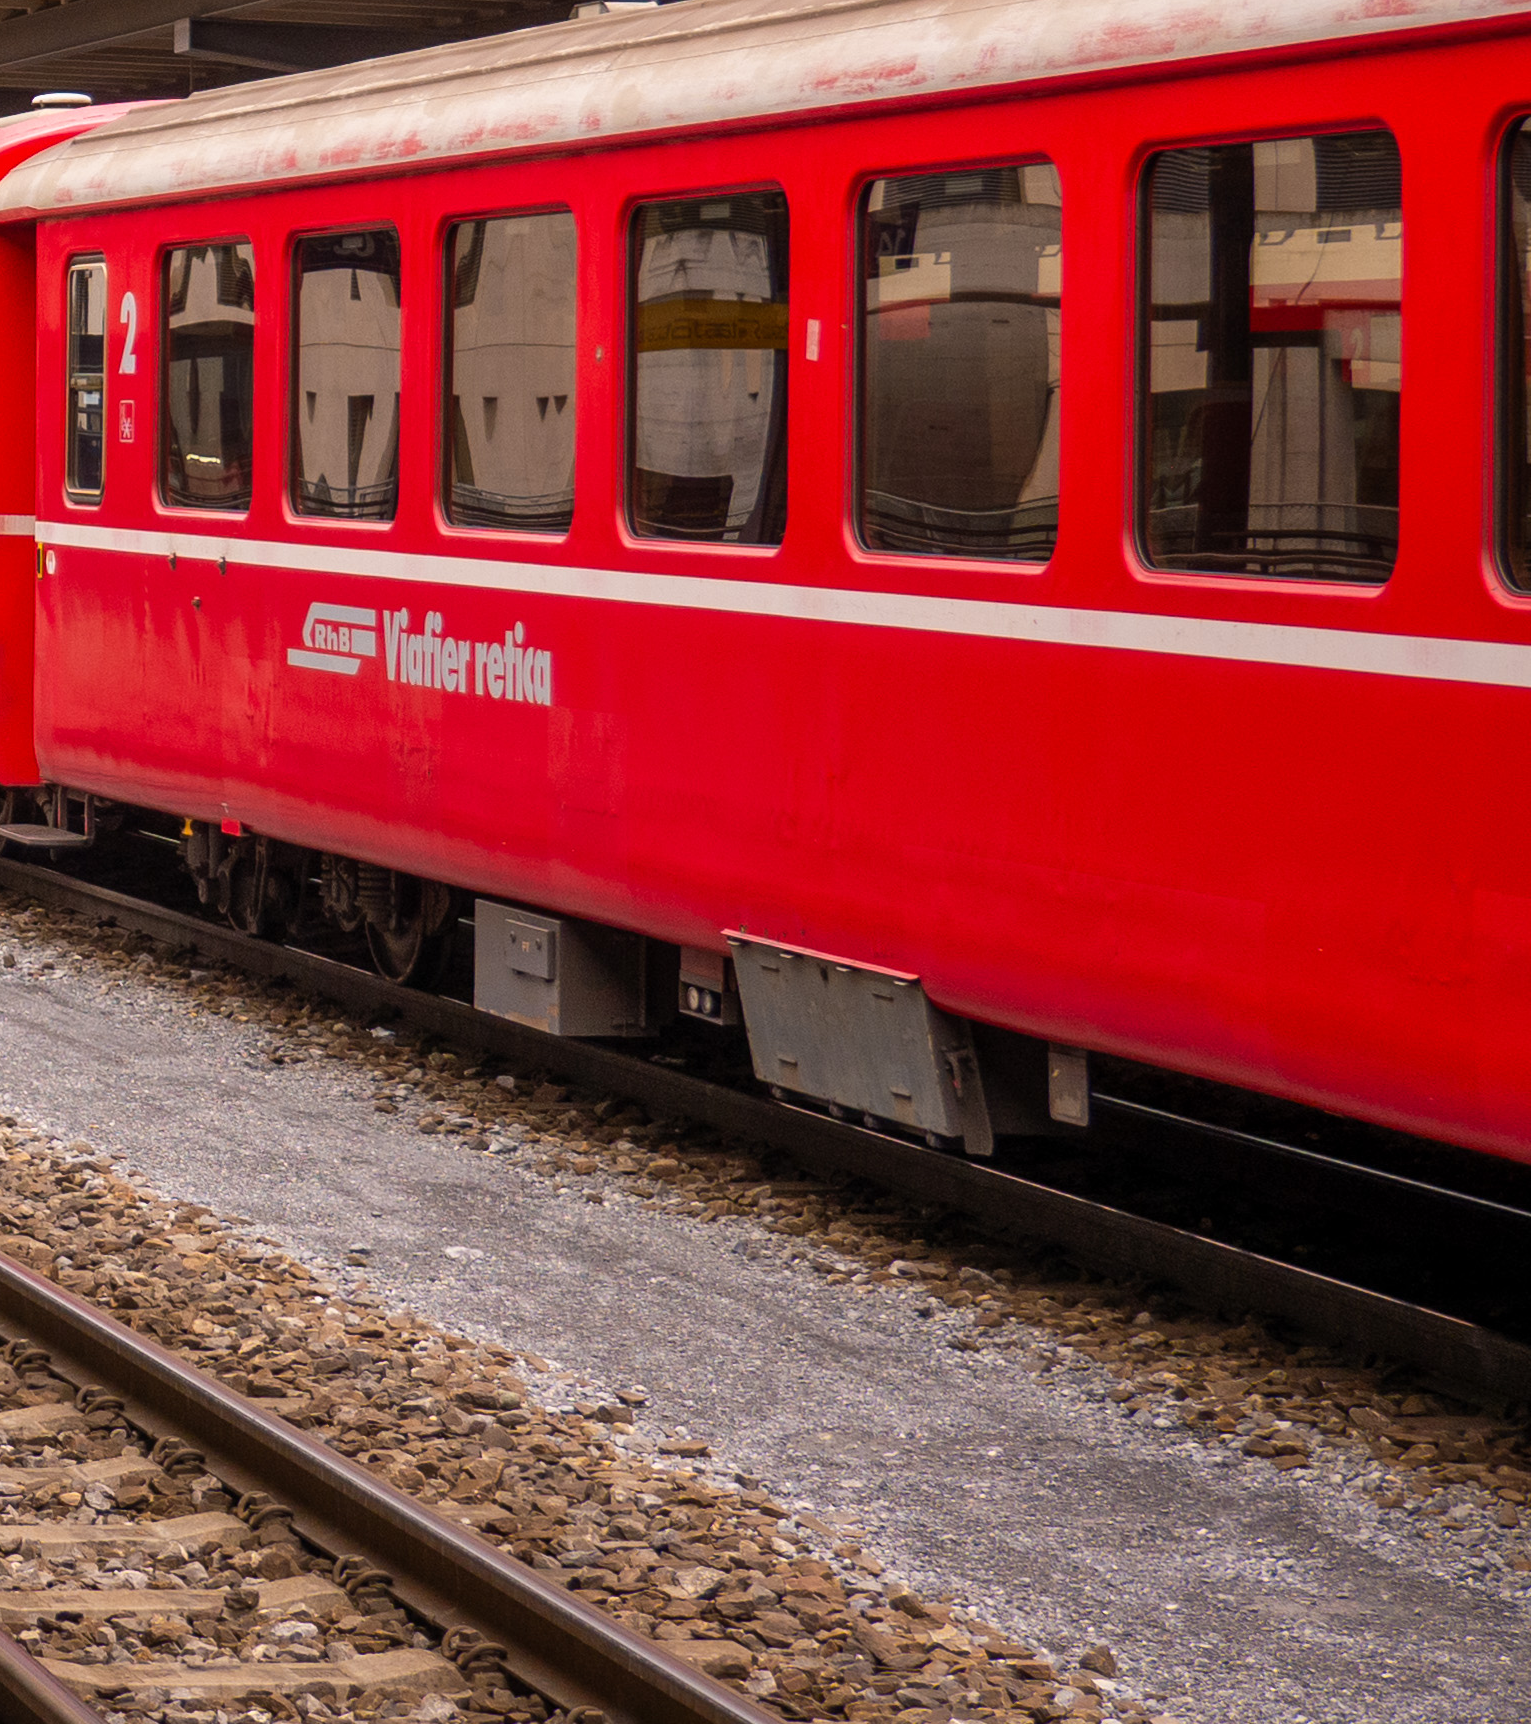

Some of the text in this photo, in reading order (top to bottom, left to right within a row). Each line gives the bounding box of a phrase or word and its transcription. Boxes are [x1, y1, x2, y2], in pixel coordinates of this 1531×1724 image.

[118, 291, 138, 375] 2
[314, 606, 552, 707] RhB Viafier retica
